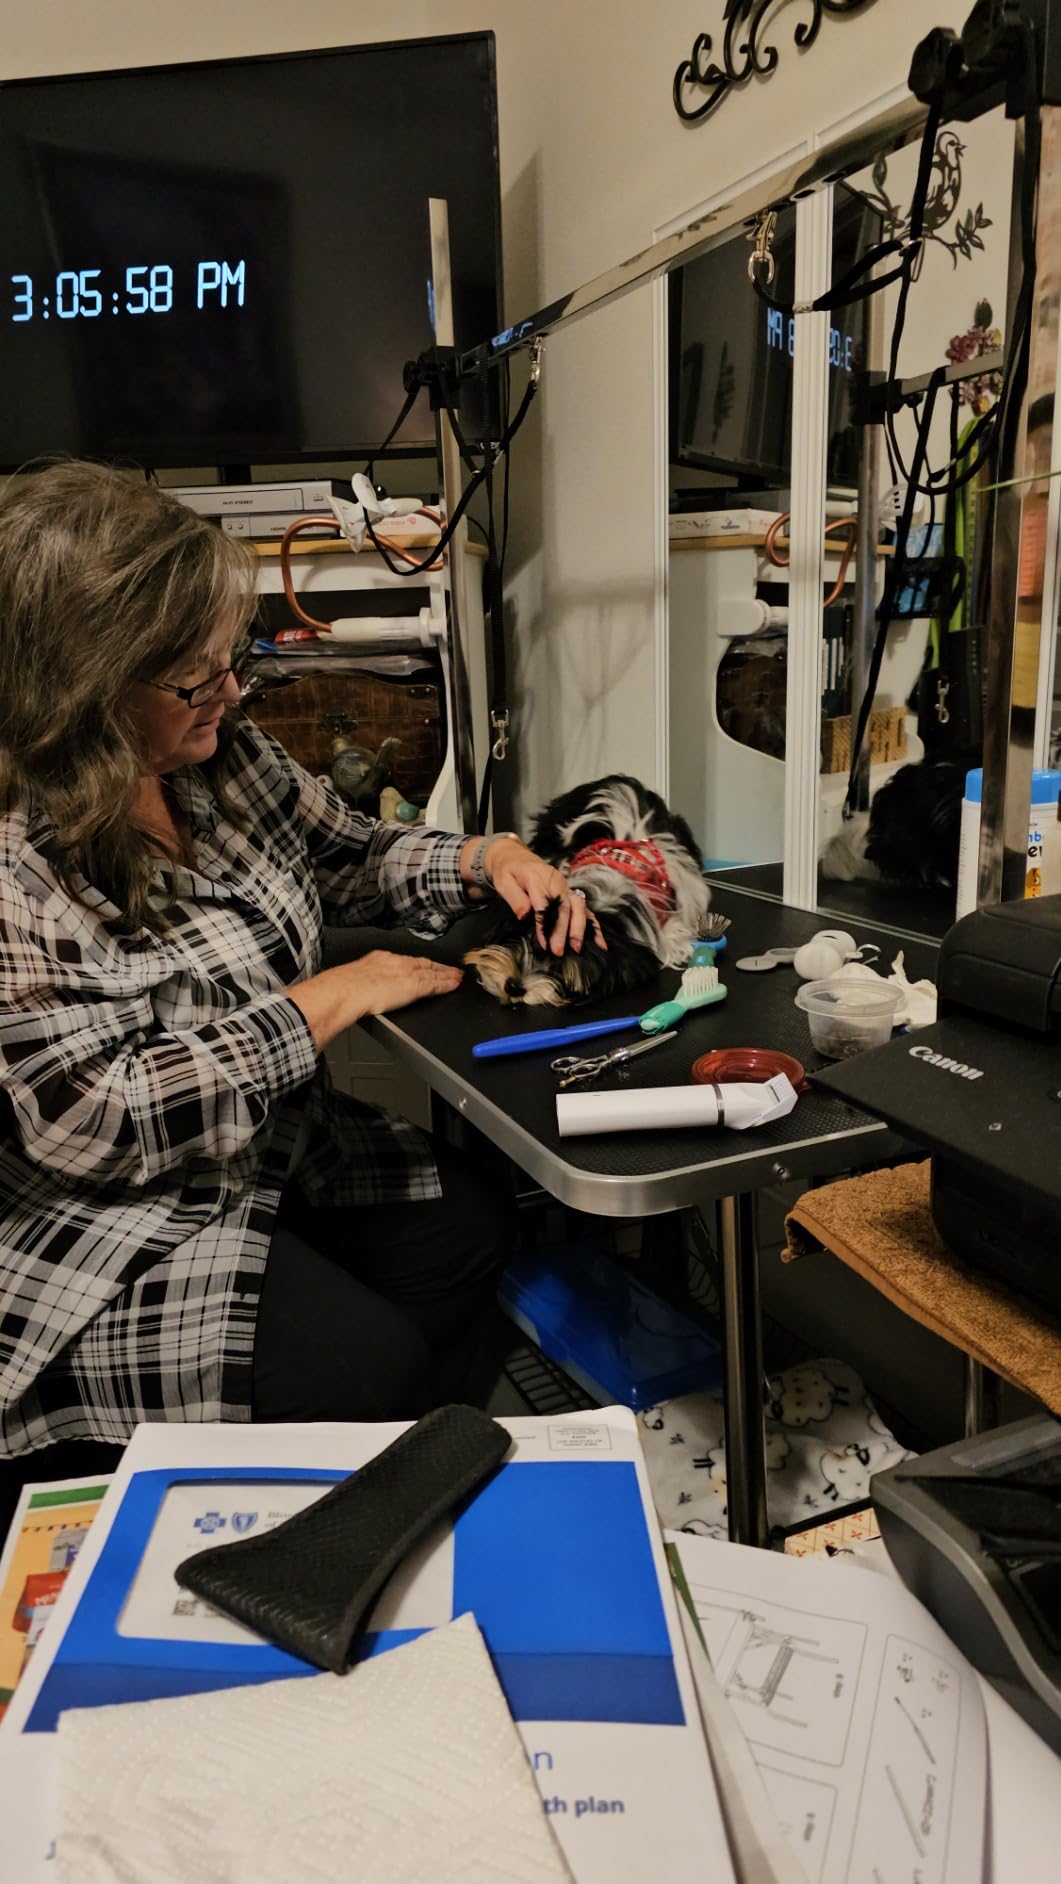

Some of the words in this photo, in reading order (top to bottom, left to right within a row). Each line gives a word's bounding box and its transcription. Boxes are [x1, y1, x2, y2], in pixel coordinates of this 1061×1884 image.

[11, 264, 173, 321] 3:05:58
[197, 259, 245, 309] PM
[908, 1045, 985, 1080] Canon
[574, 1796, 625, 1818] plan
